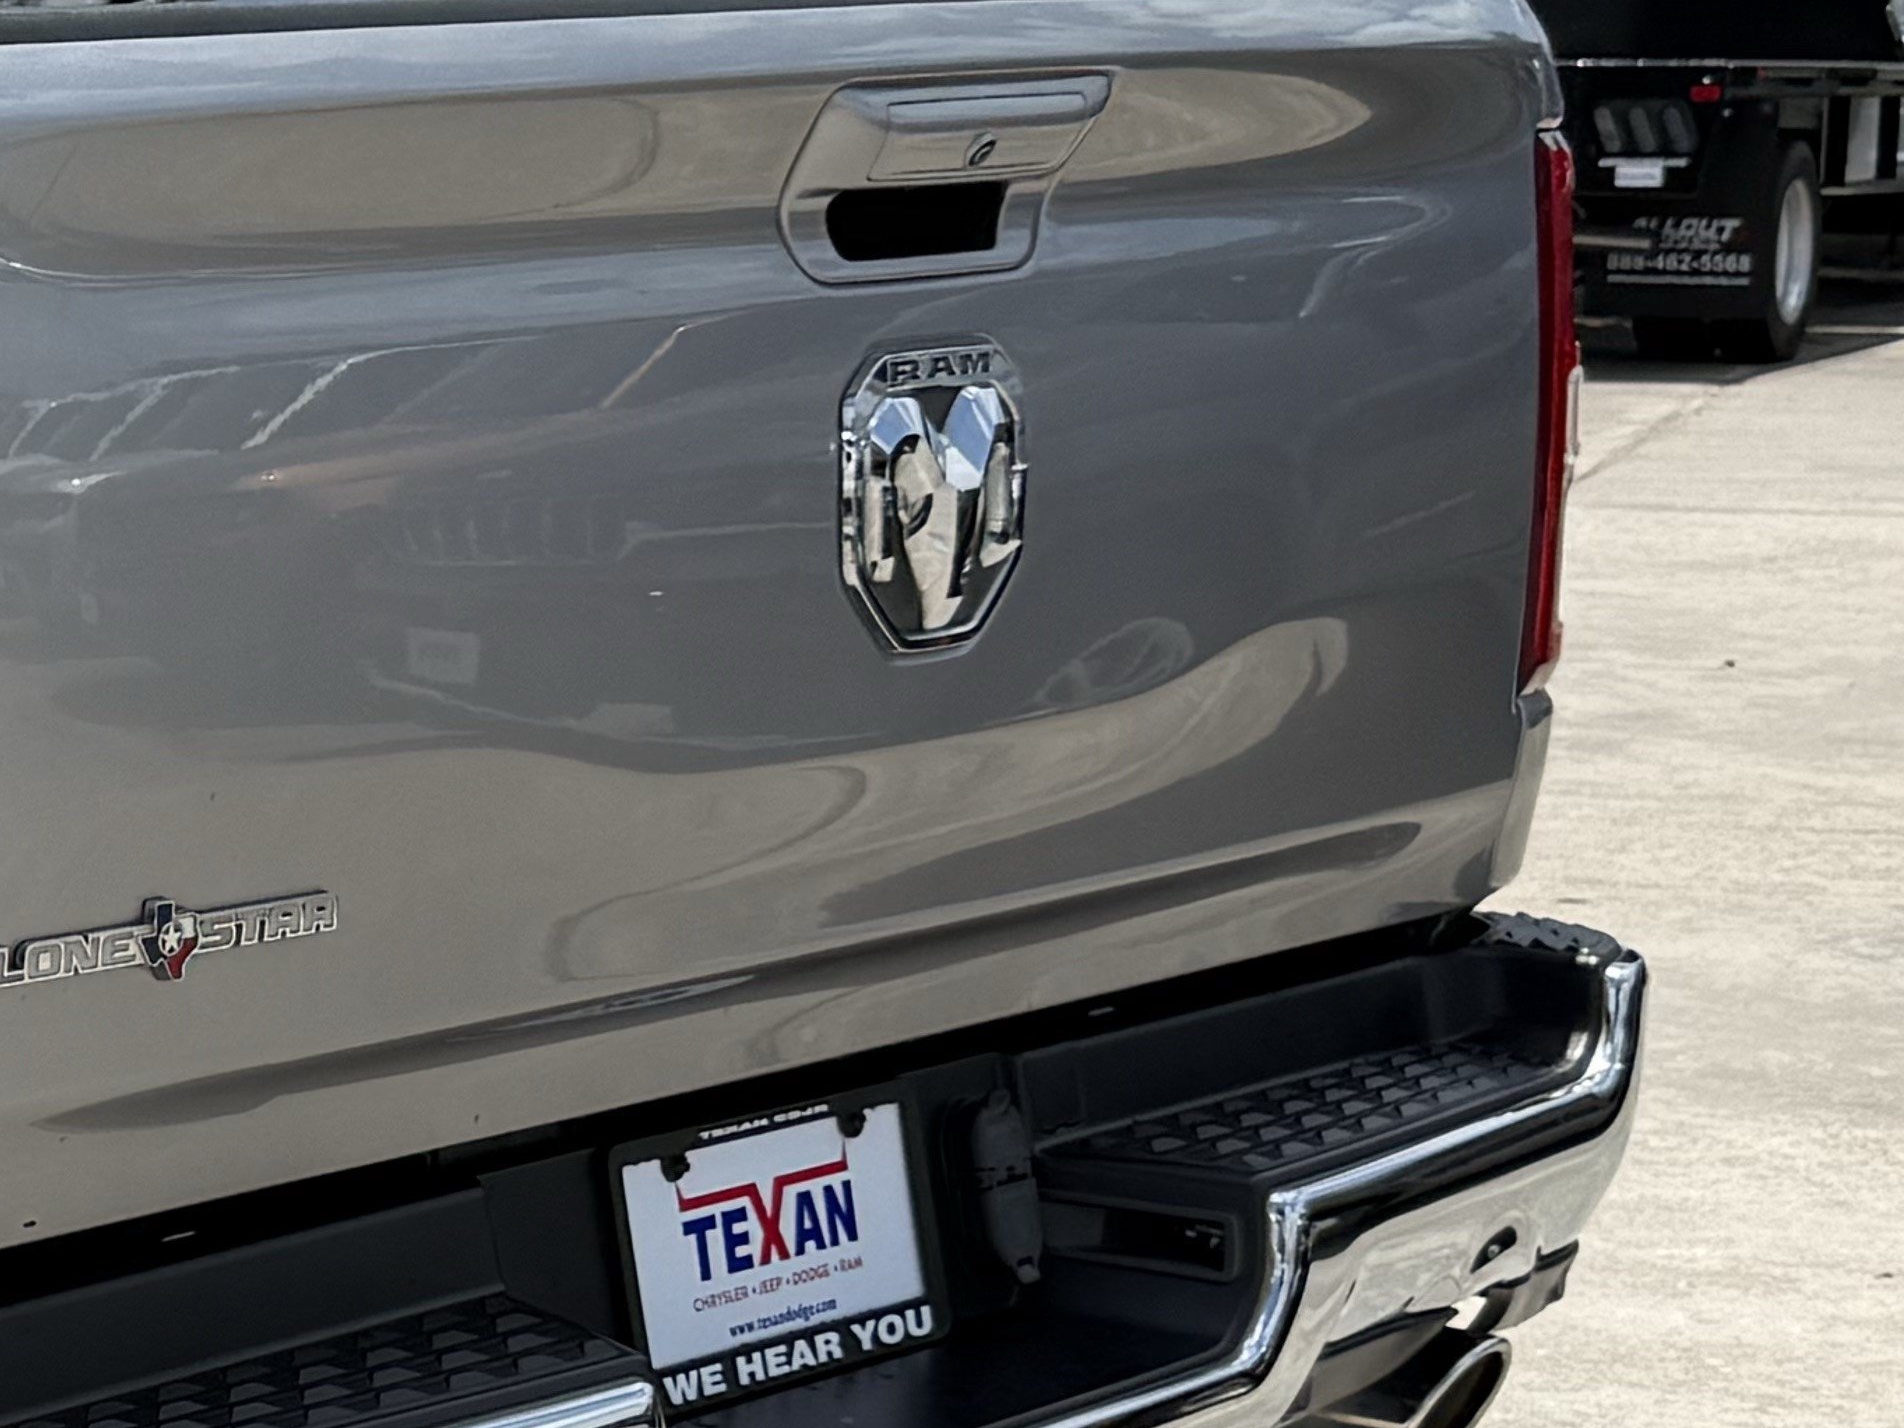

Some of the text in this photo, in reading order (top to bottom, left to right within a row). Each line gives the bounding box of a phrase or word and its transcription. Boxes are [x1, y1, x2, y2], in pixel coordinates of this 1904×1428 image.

[889, 352, 991, 384] RAM
[195, 890, 340, 954] STAR
[681, 1172, 859, 1282] TEXAN
[692, 1256, 864, 1313] CHRYSLER JEEP DODGE RAM
[663, 1305, 933, 1406] WE HEAR YOU
